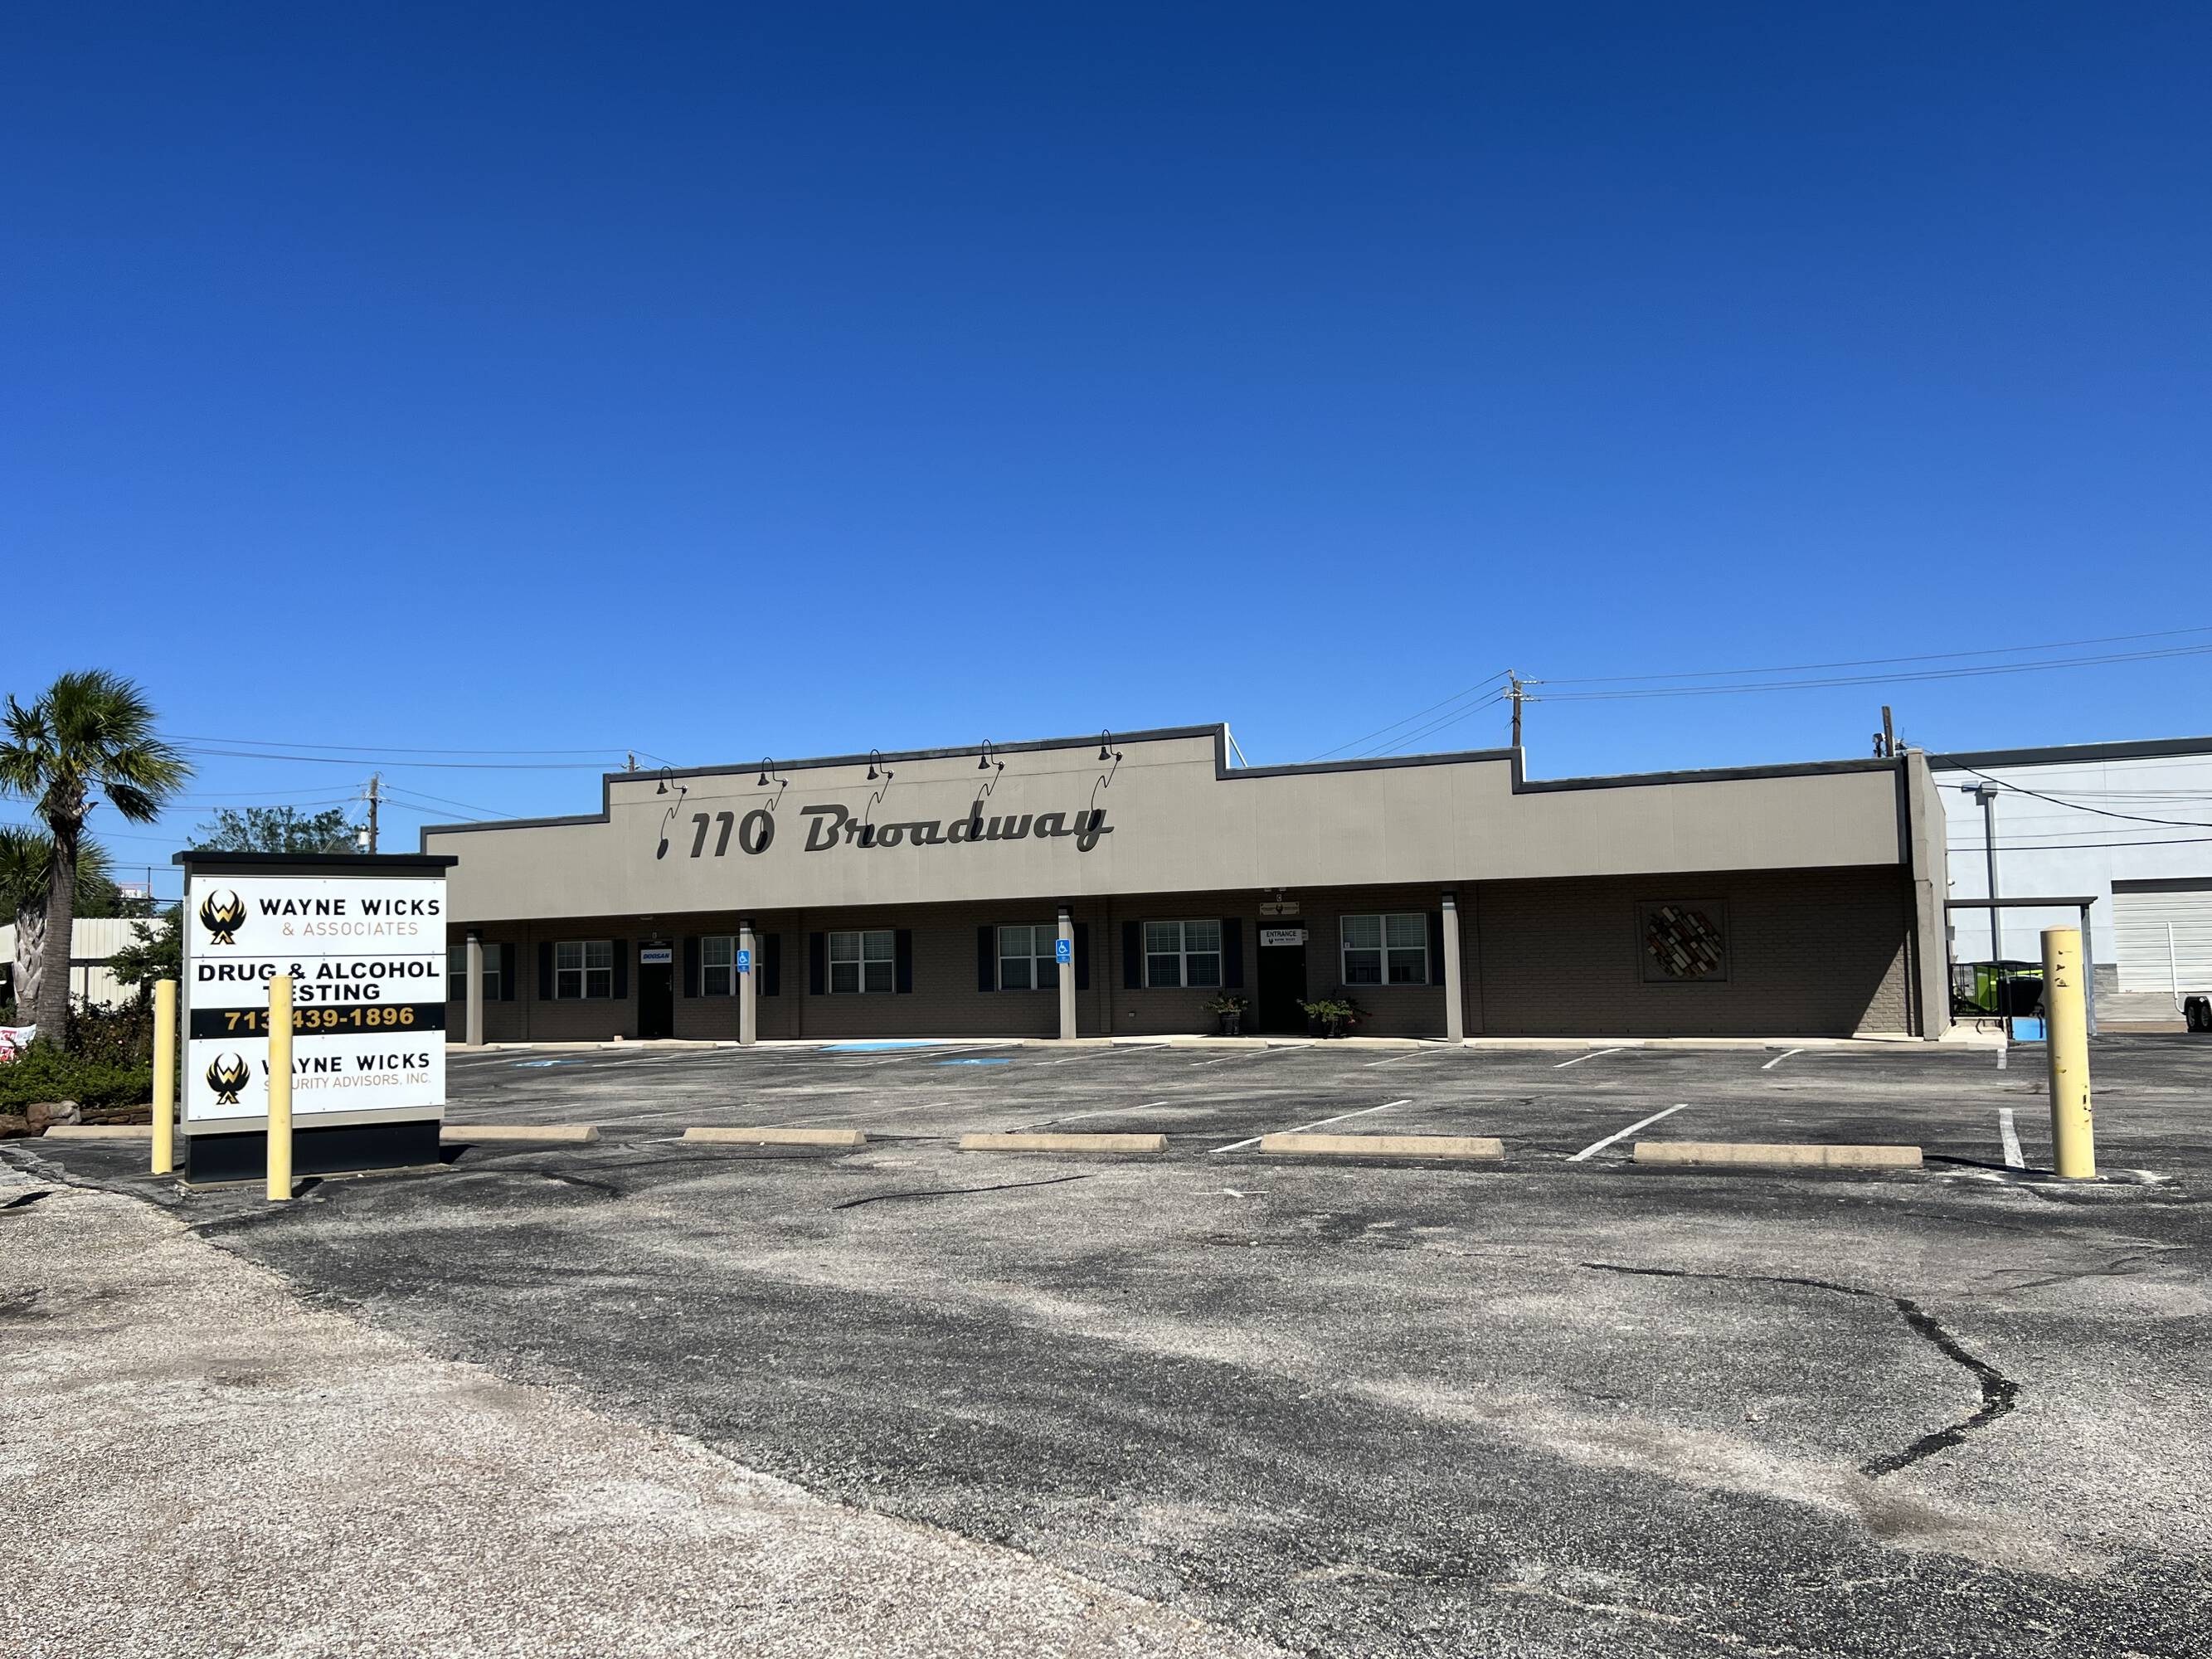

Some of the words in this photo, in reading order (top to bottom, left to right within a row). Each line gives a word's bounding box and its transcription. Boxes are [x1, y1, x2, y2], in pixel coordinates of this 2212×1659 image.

[690, 809, 775, 858] 110
[800, 800, 1114, 852] Broadway
[260, 898, 346, 916] WAYNE
[361, 898, 440, 916] WICKS
[282, 922, 294, 936] &
[304, 922, 418, 936] ASSOCIATES
[198, 963, 276, 981] DRUG
[288, 963, 306, 980] &
[316, 961, 440, 980] ALCOHOL
[263, 983, 380, 1002] STING
[225, 1007, 415, 1030] 713439-1896
[356, 1053, 430, 1071] WICKS
[264, 1078, 328, 1092] SURITY
[406, 1073, 431, 1084] INC.
